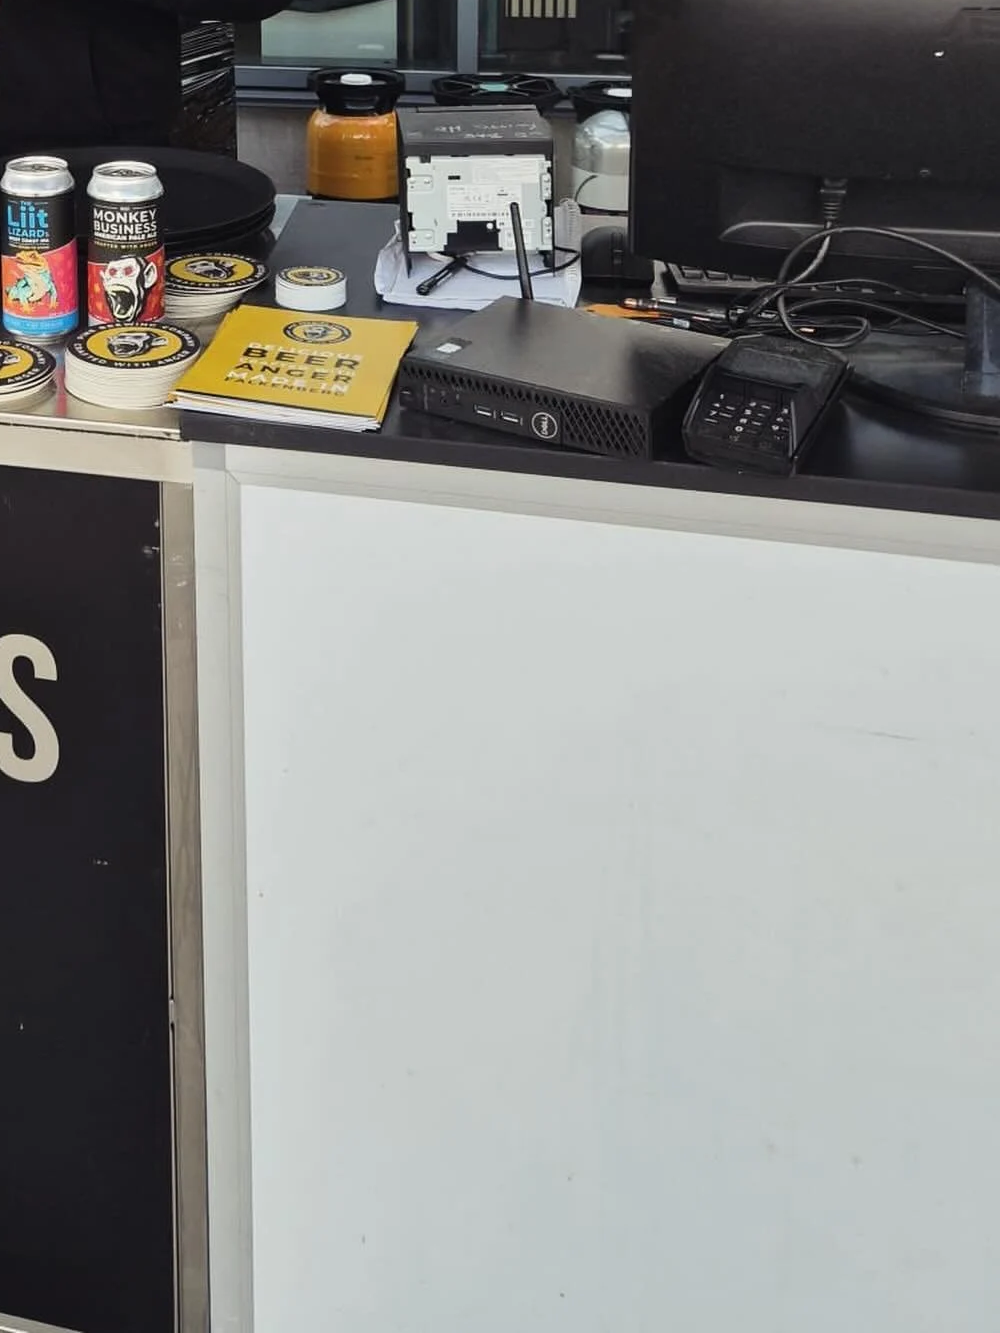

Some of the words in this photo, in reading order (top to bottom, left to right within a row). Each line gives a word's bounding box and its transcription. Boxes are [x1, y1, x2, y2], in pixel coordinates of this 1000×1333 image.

[93, 208, 157, 223] MONKEY
[93, 220, 157, 235] BUSINESS
[242, 347, 361, 370] BEER
[7, 367, 40, 384] ANGER
[226, 371, 306, 387] MADE
[320, 382, 350, 393] IN
[235, 363, 352, 383] ANGER
